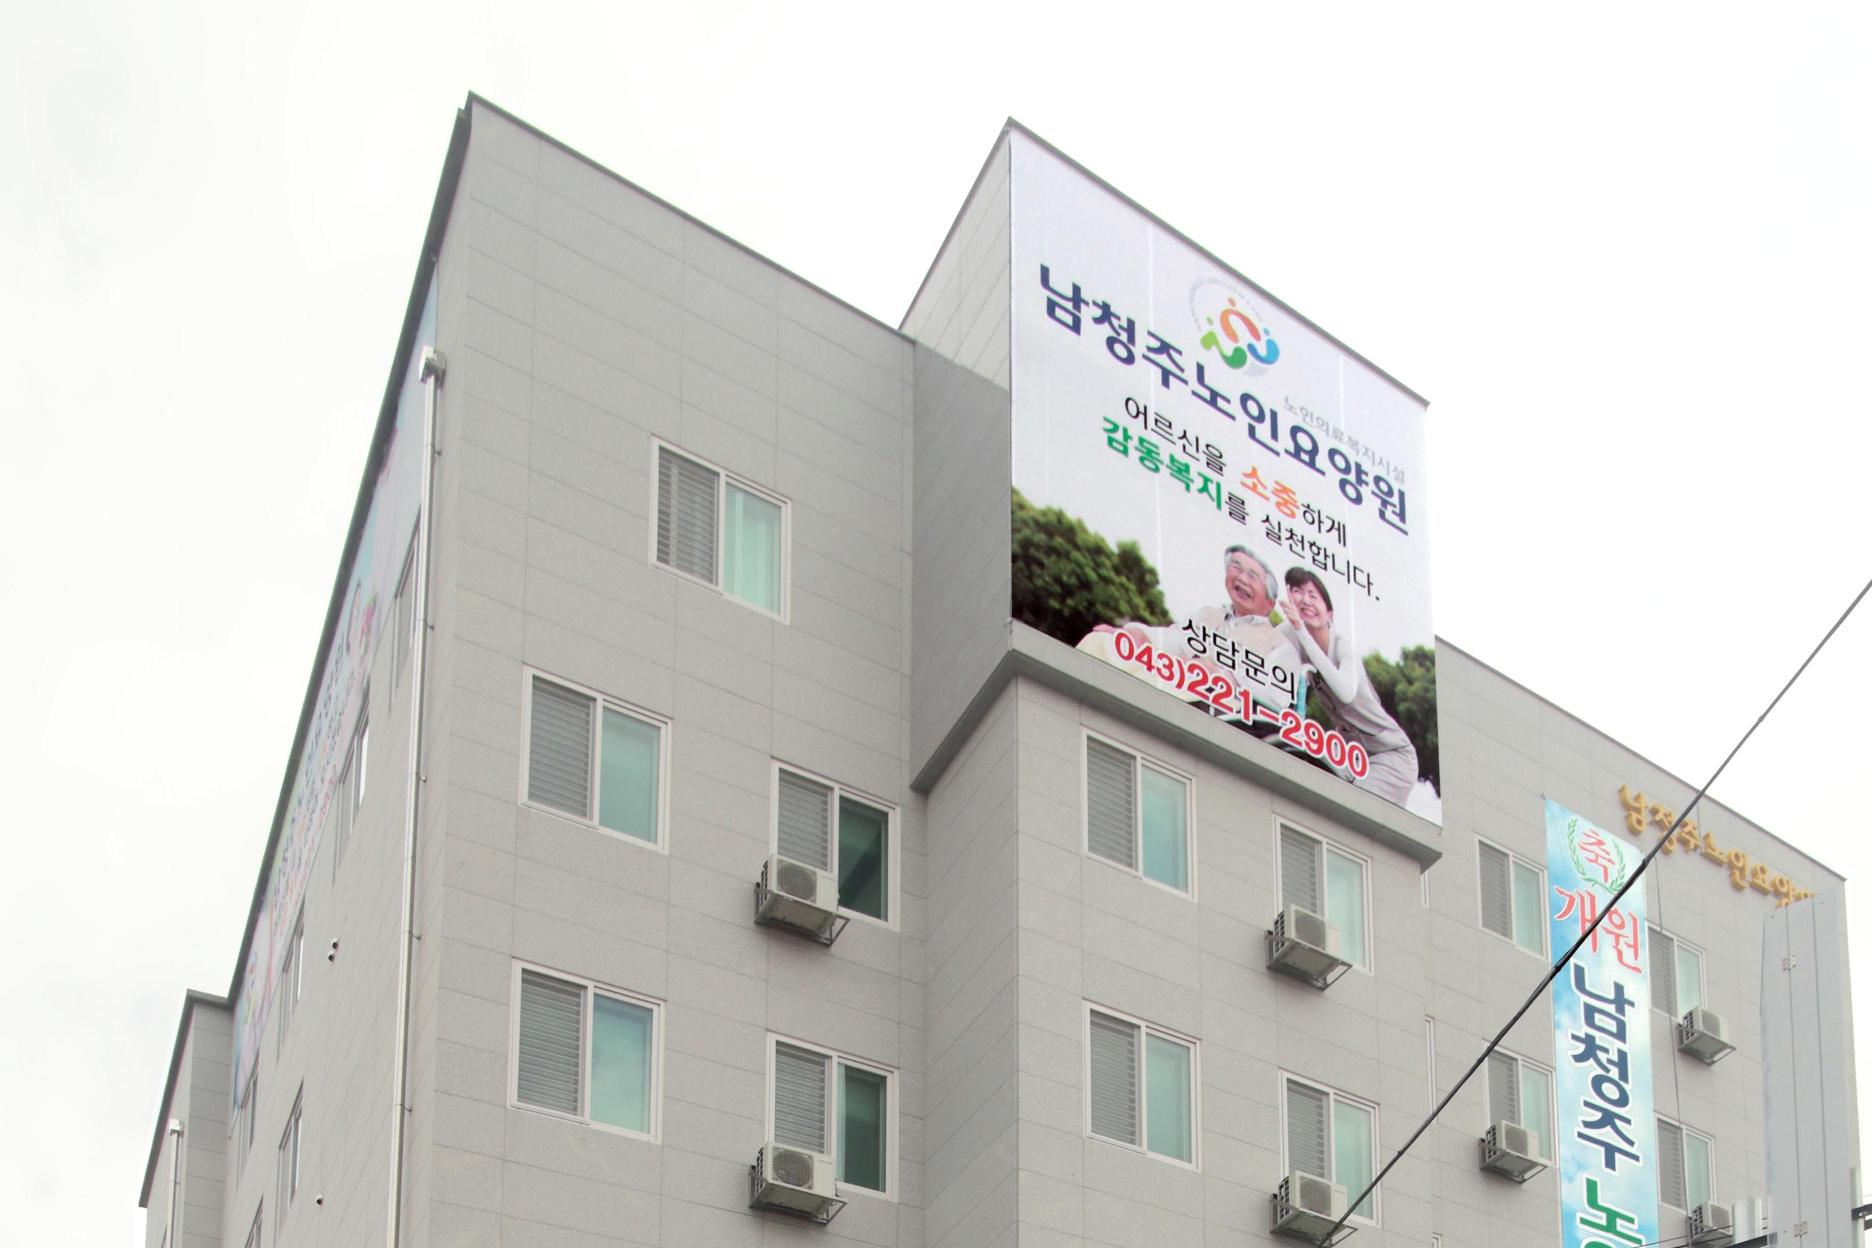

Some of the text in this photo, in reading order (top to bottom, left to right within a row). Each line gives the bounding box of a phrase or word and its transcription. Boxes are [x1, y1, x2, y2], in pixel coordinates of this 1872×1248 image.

[1039, 263, 1409, 536] 남청주노인요양원
[1283, 395, 1407, 483] 노인의료복지시설
[1102, 416, 1381, 601] 감동복지를 실천합니다.
[1125, 396, 1347, 548] 어르신을 소중하게
[1113, 631, 1369, 779] 043)221-2900
[1181, 618, 1297, 702] 상담문의
[1577, 829, 1616, 884] 축
[1554, 885, 1643, 975] 개원
